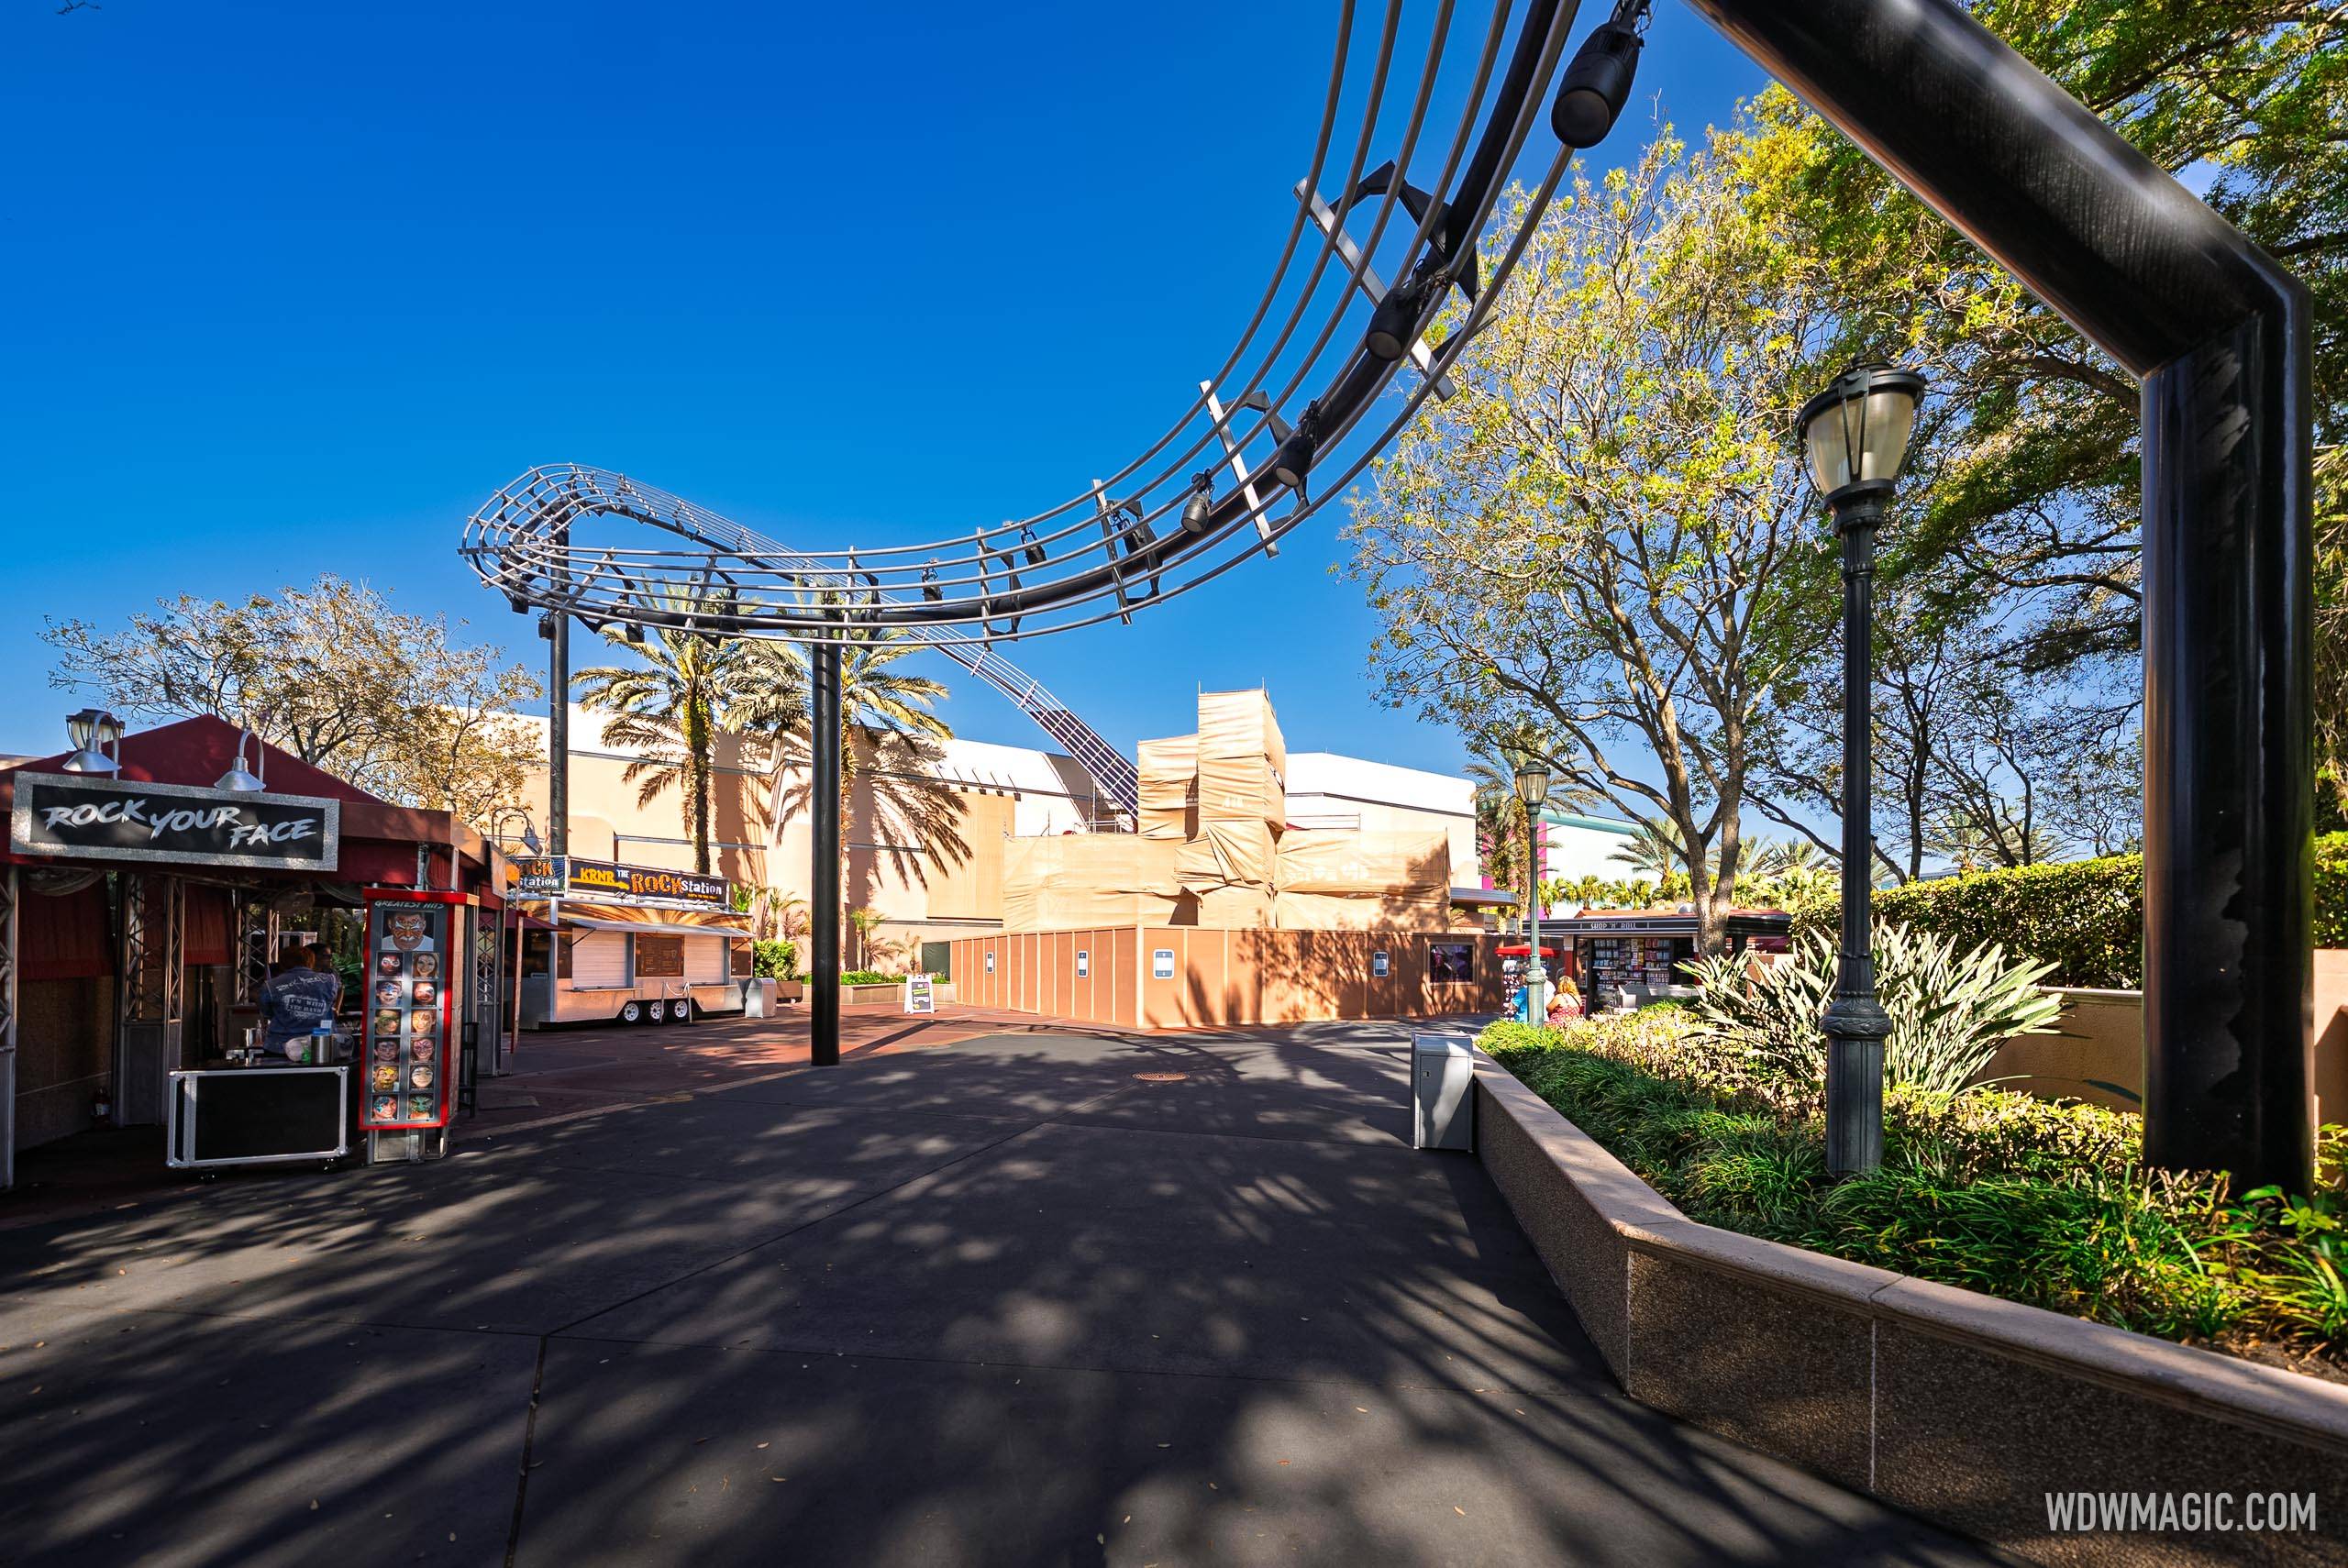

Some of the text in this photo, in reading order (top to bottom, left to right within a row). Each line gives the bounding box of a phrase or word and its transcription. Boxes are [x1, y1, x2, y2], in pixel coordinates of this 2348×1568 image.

[40, 799, 317, 849] ROCK YOUR FACE
[518, 859, 556, 878] OCK
[580, 867, 615, 883] KRNR
[616, 869, 630, 878] THE
[630, 873, 683, 895] ROCK
[374, 900, 421, 908] GREATEST
